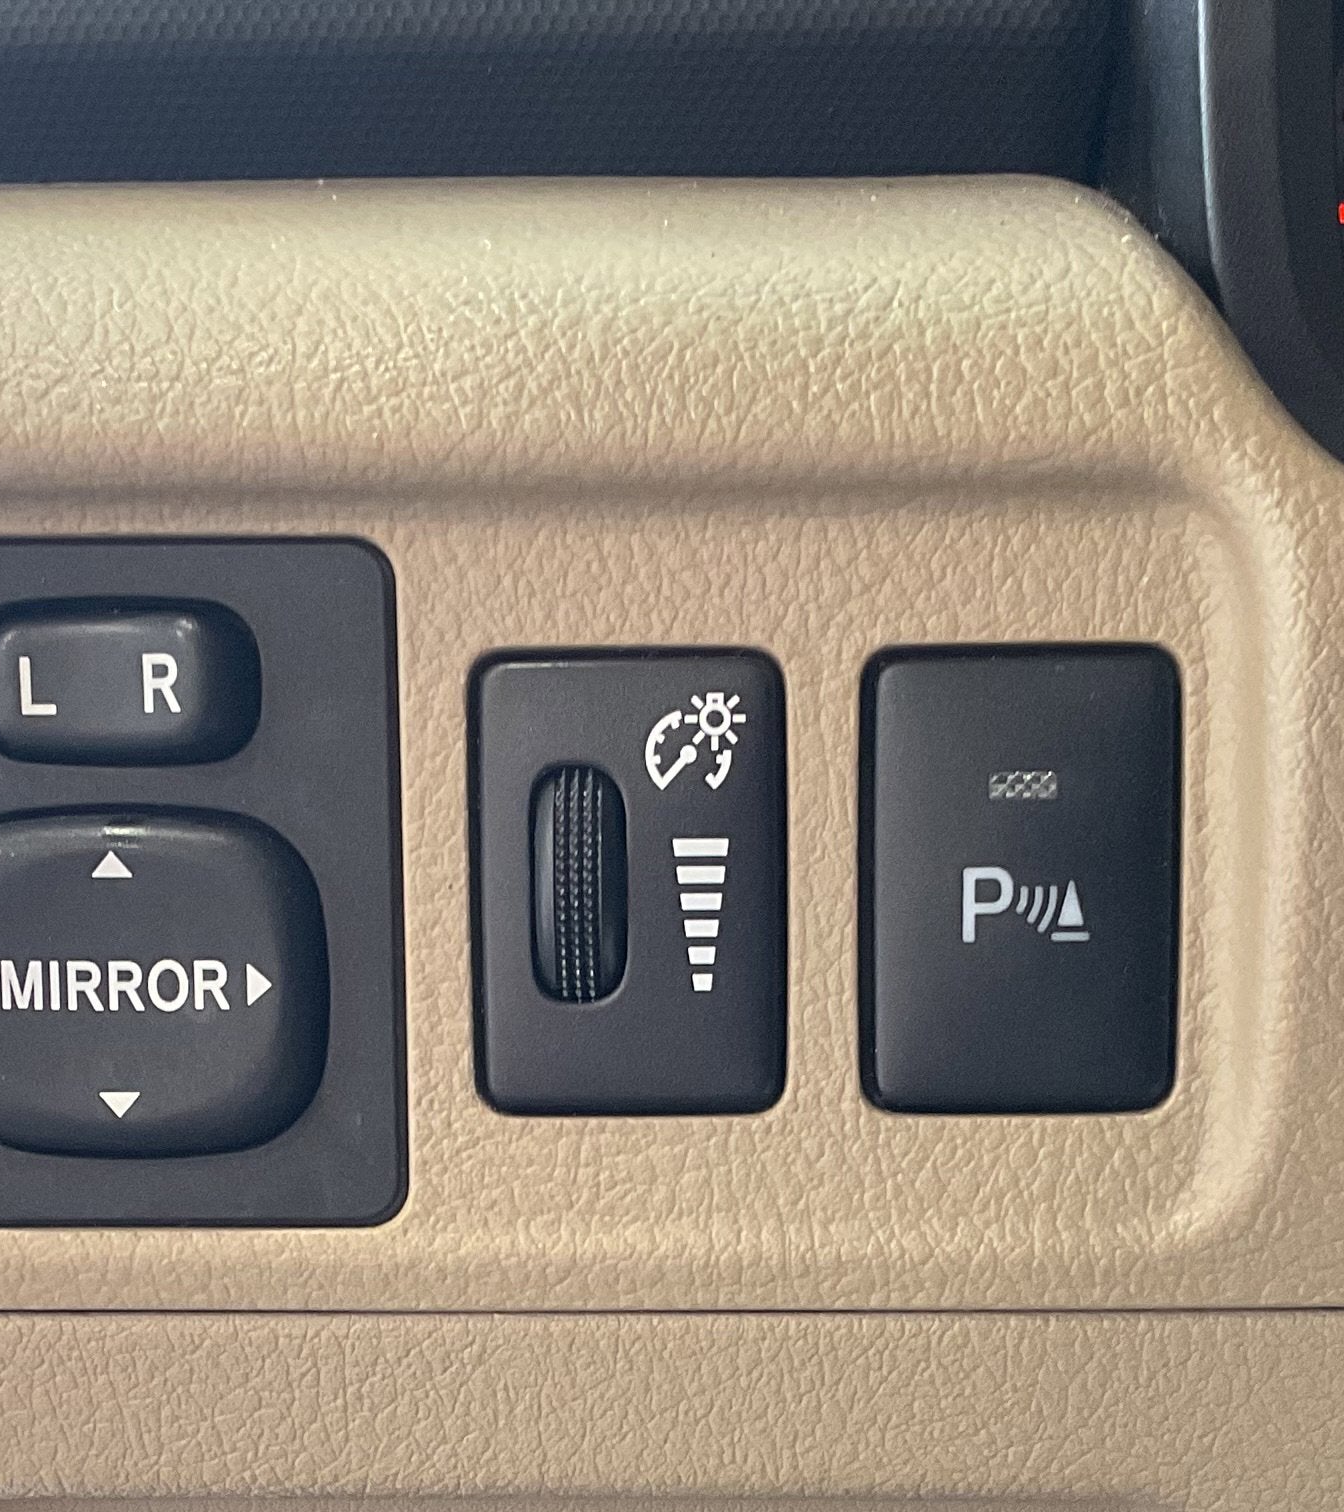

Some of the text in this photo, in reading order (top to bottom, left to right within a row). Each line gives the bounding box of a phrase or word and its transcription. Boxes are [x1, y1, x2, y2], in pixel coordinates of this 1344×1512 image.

[18, 652, 182, 716] L R
[962, 866, 1014, 943] P
[0, 959, 230, 1012] MIRROR
